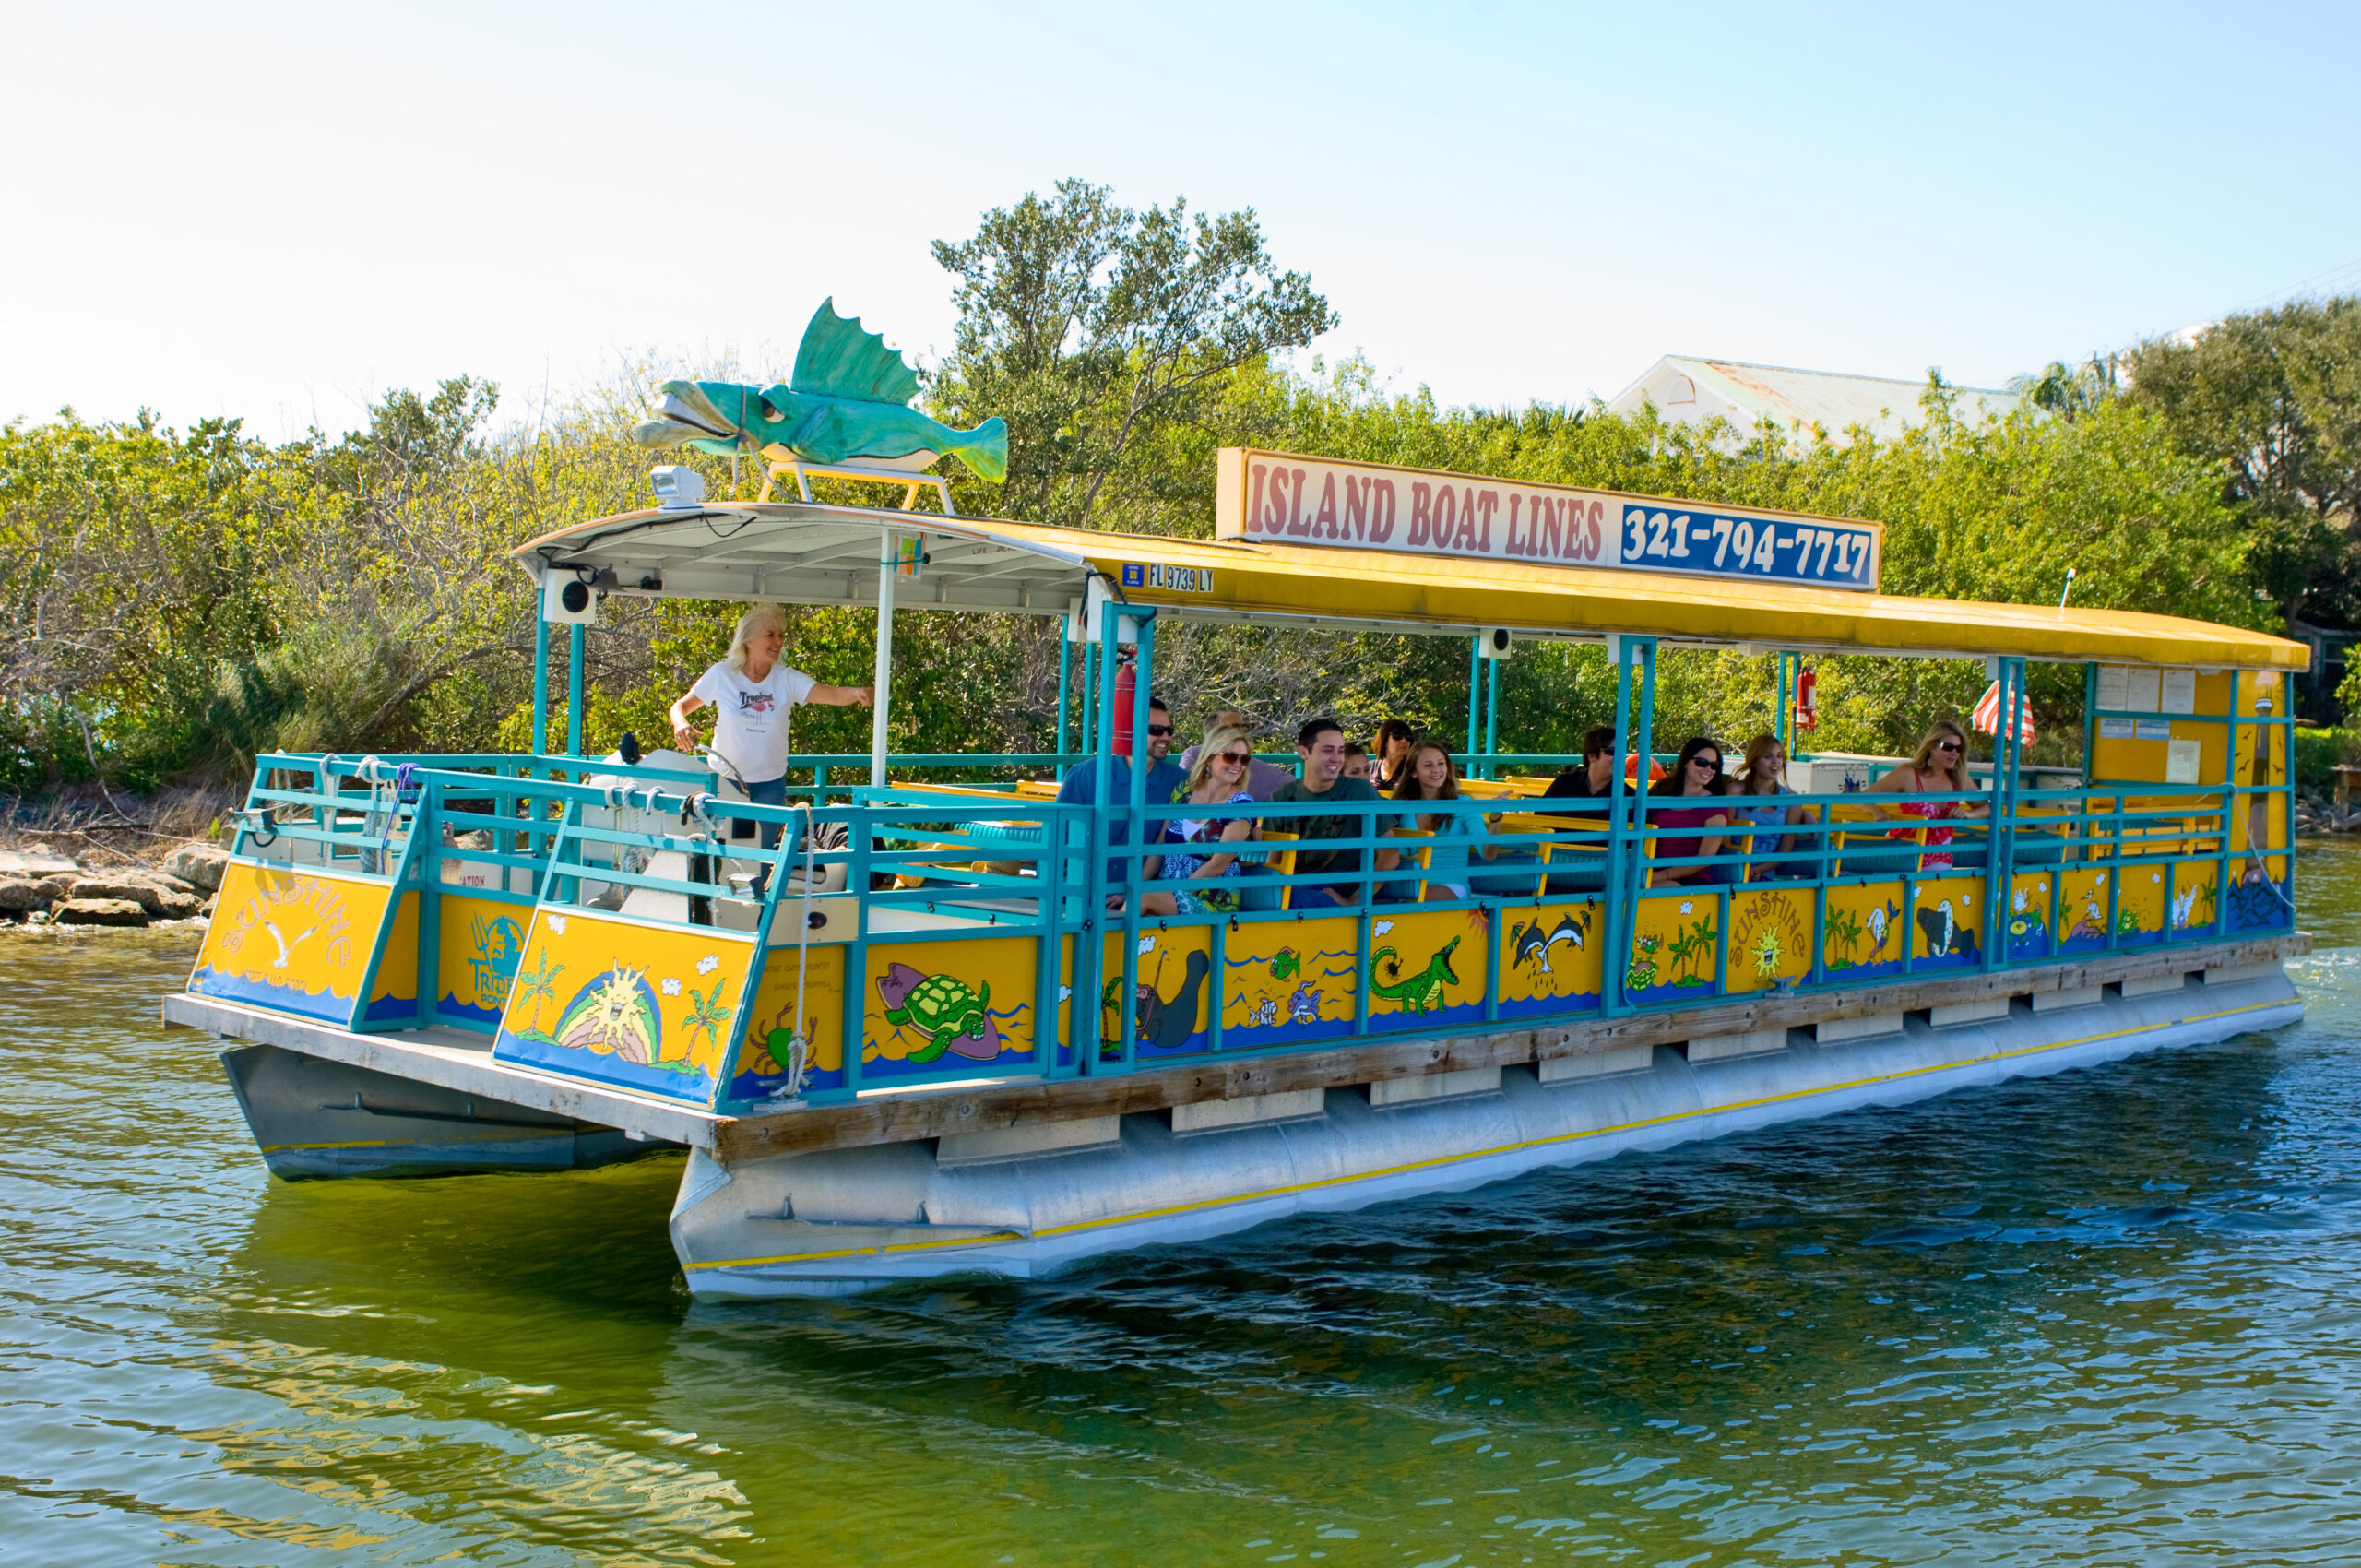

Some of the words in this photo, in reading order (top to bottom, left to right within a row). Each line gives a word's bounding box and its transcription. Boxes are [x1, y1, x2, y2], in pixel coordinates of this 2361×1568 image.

[1248, 464, 1396, 543] ISLAND
[1407, 481, 1499, 552] BOAT
[1505, 493, 1603, 561] LINES
[1623, 509, 1870, 580] 321-794-7717
[972, 547, 988, 555] LIFE
[1149, 564, 1163, 587] FL
[1167, 566, 1196, 590] 9739
[1199, 569, 1213, 591] LY
[460, 875, 485, 887] ATION
[222, 874, 352, 968] SUNSHINE
[1729, 891, 1806, 968] SUNSHINE
